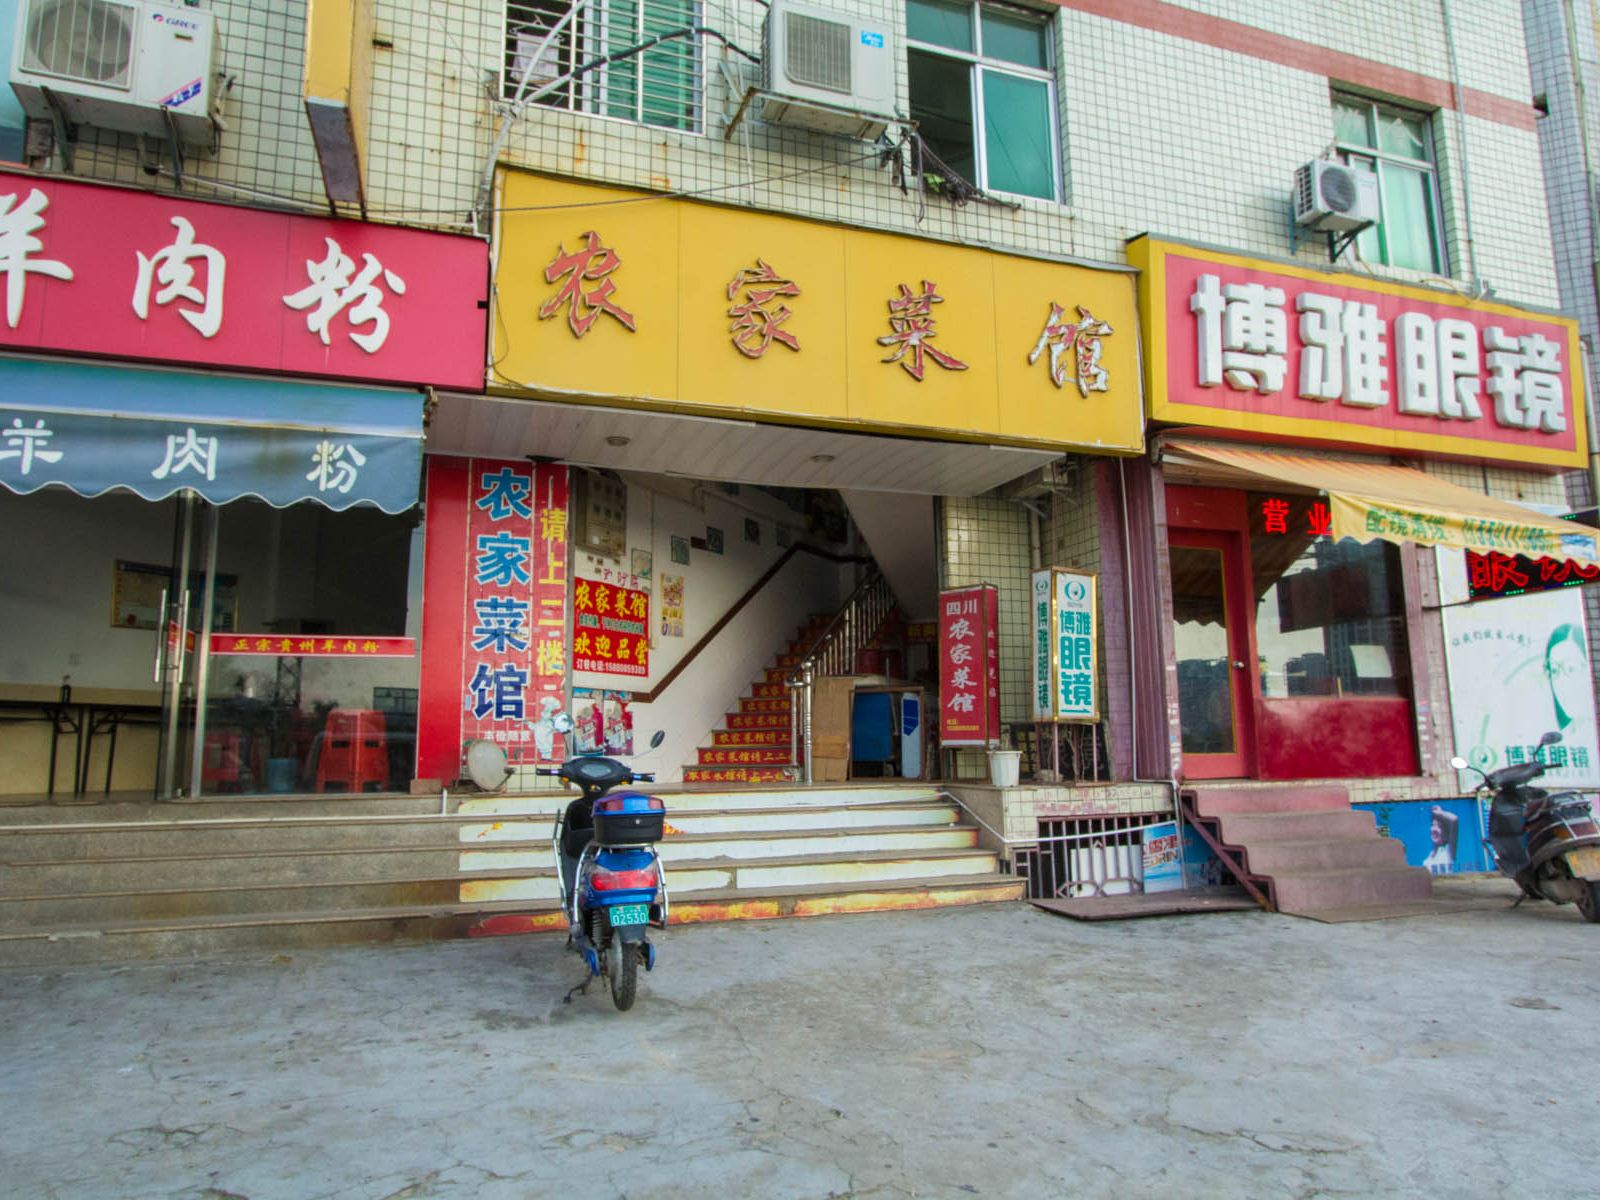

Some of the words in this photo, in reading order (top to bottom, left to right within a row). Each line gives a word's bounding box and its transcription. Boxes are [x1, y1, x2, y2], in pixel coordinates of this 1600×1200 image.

[0, 188, 407, 354] 羊肉粉
[539, 230, 1114, 398] 农家菜馆
[1190, 273, 1567, 433] 博雅眼镜
[0, 417, 367, 494] 羊肉粉
[1263, 499, 1332, 535] 营业
[467, 466, 532, 722] 农家菜馆
[575, 581, 648, 619] 农家菜馆
[946, 599, 977, 615] 四川
[1059, 609, 1091, 635] 博雅
[233, 638, 380, 654] 正宗贵州羊肉粉
[947, 618, 977, 713] 农家菜馆
[1059, 636, 1092, 706] 眼镜
